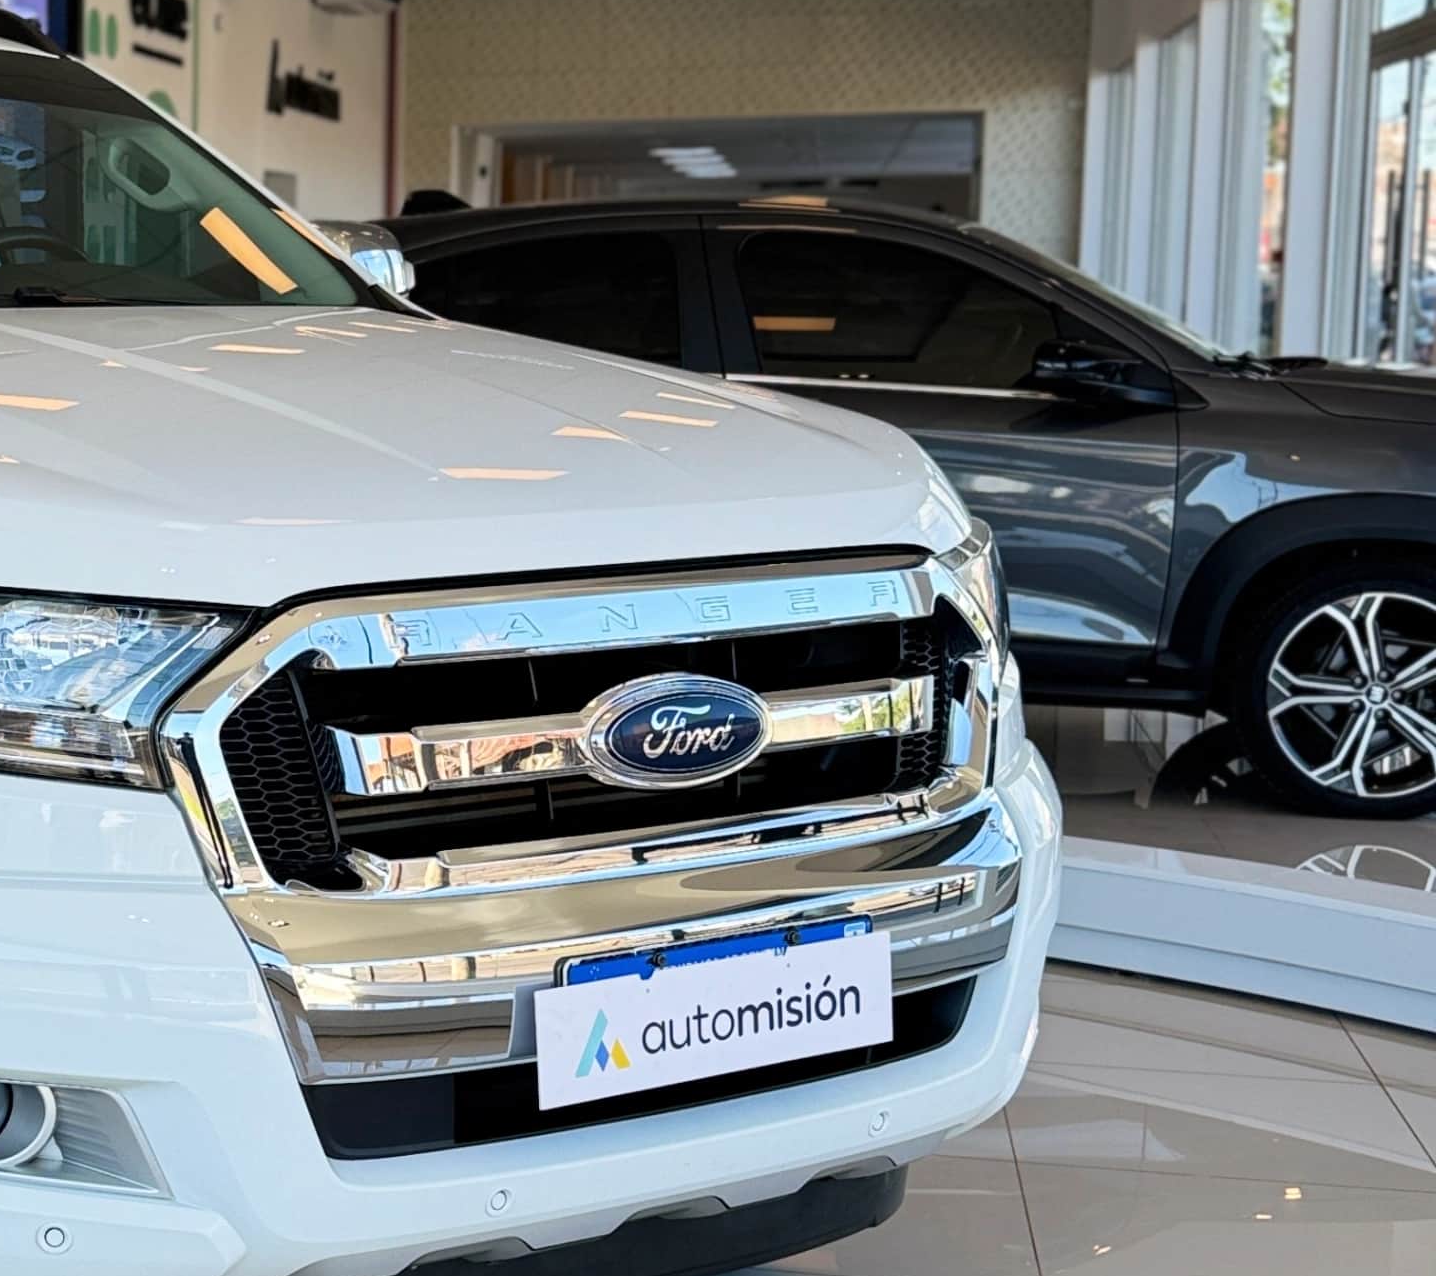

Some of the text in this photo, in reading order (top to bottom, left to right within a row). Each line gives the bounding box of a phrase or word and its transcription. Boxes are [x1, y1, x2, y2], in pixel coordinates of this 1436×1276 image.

[389, 579, 901, 650] RANGER
[642, 703, 736, 760] Ford
[641, 974, 862, 1056] automisión
